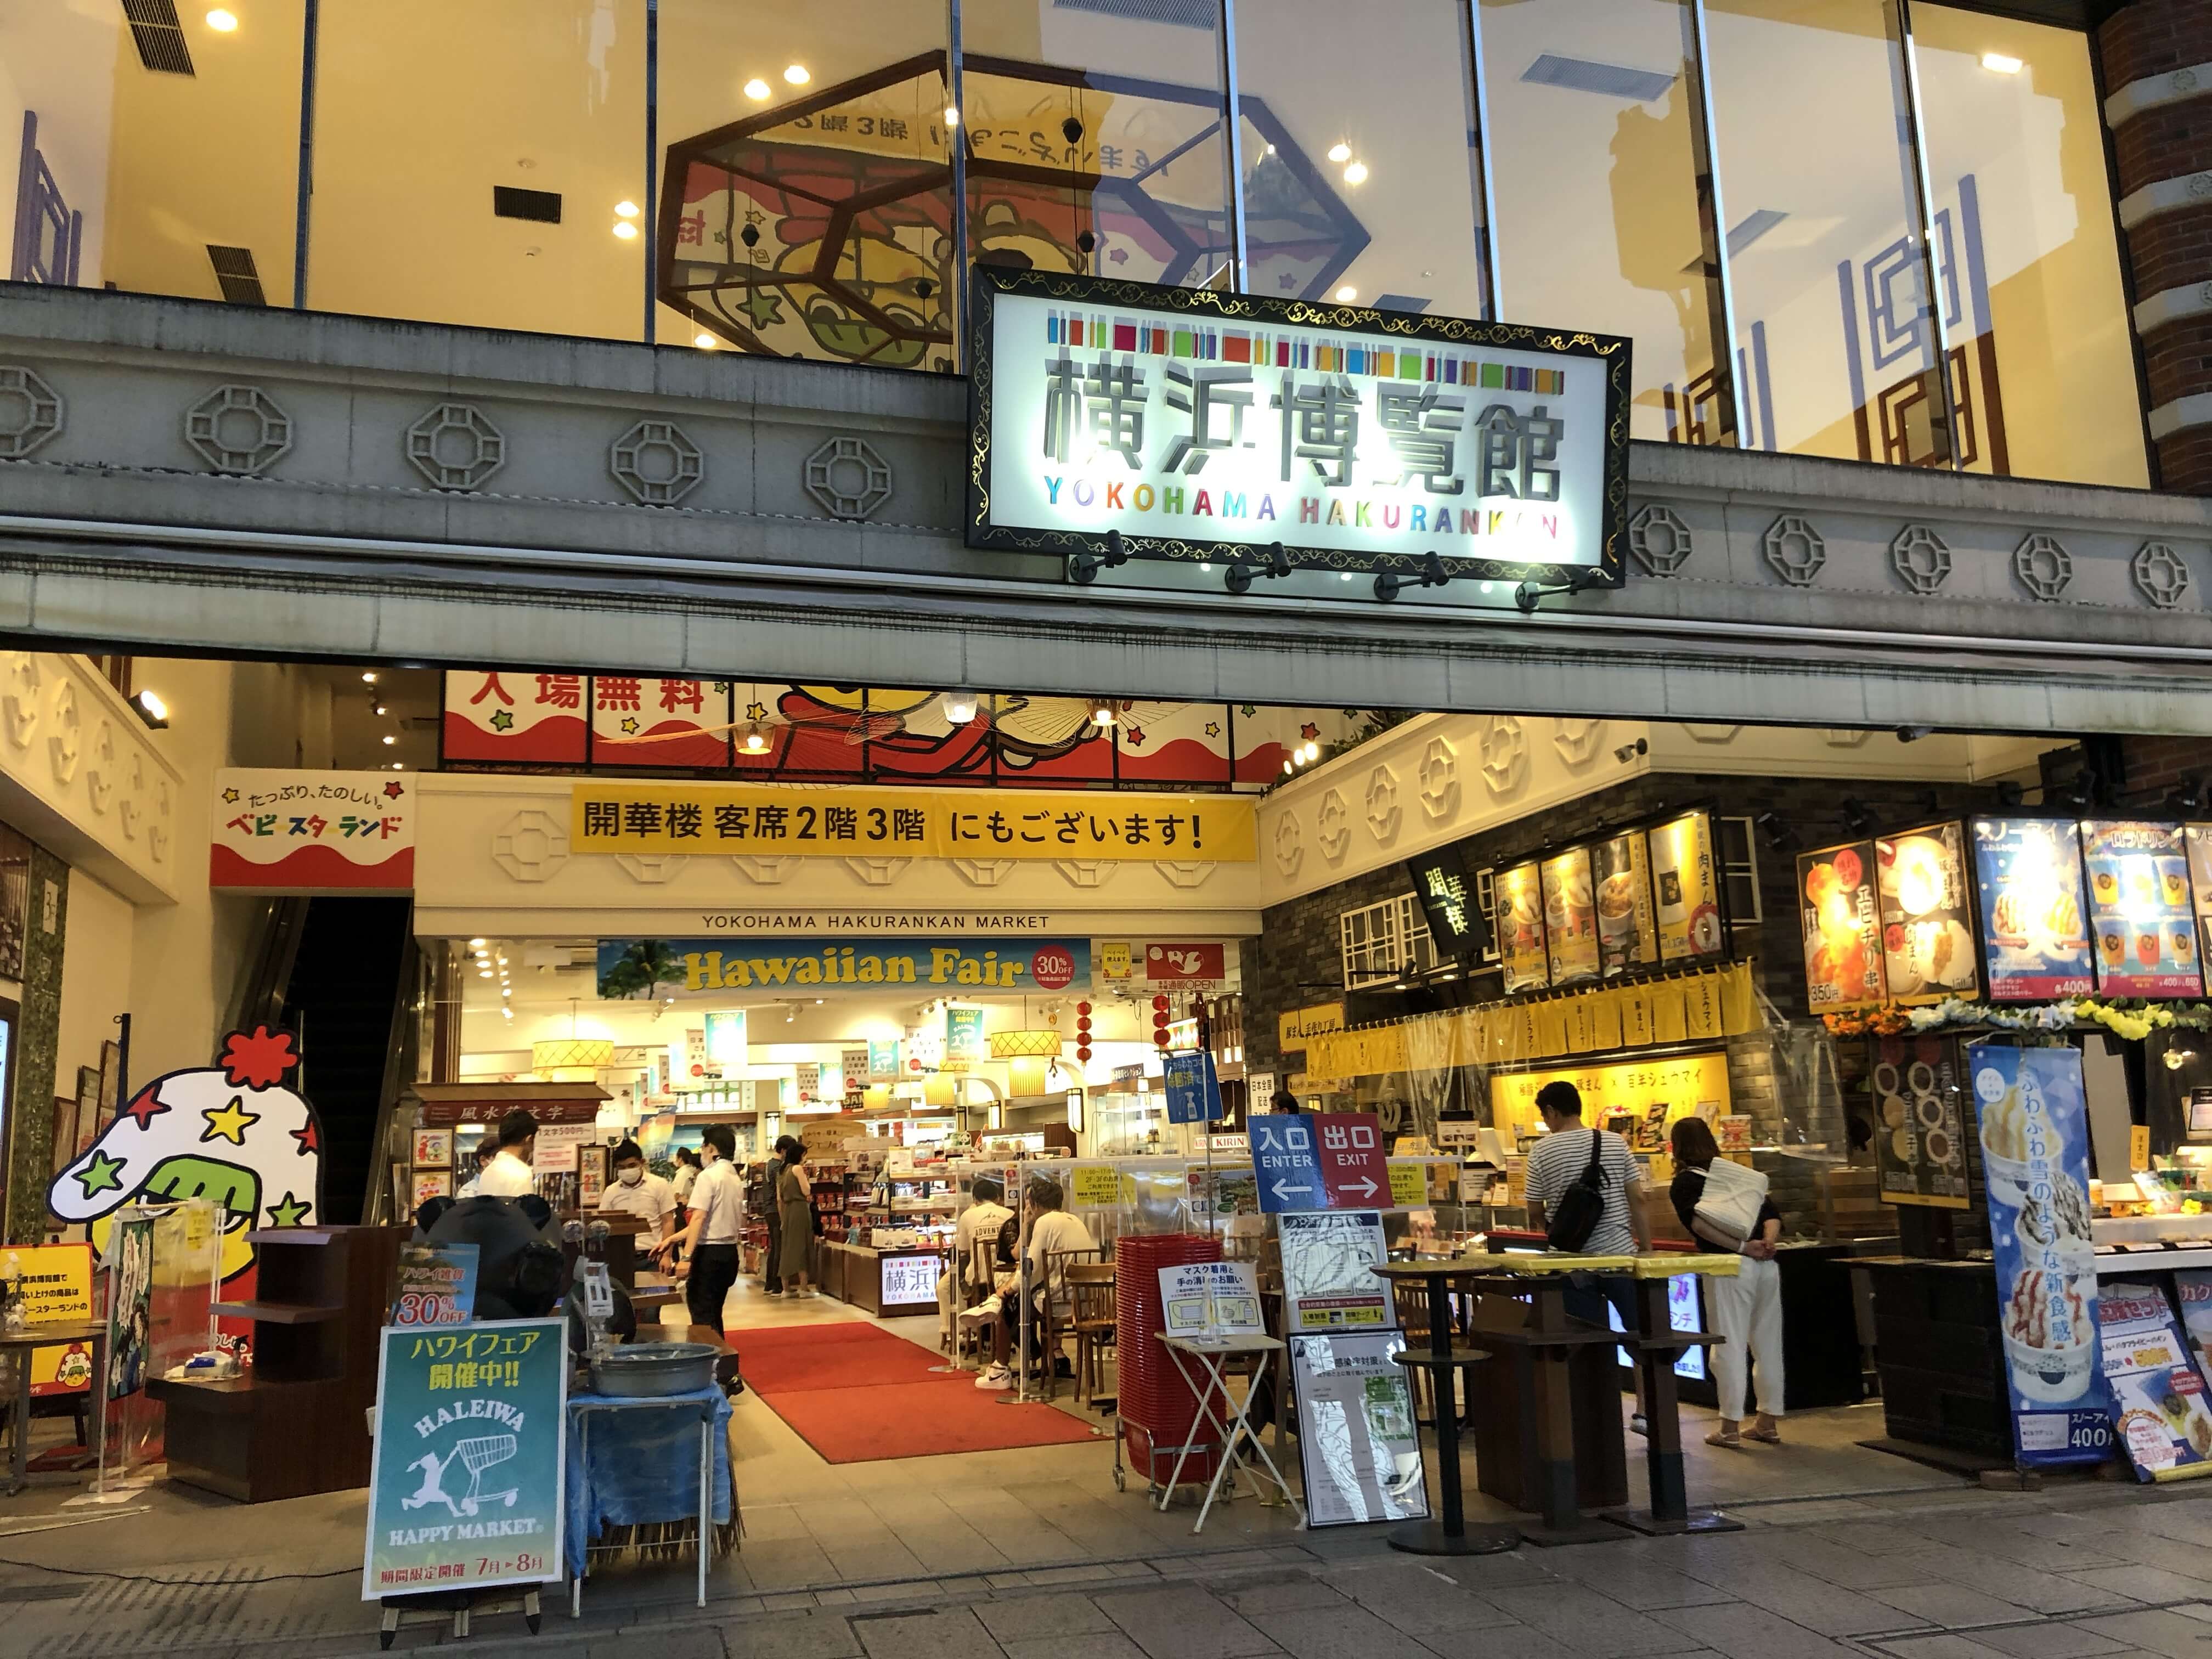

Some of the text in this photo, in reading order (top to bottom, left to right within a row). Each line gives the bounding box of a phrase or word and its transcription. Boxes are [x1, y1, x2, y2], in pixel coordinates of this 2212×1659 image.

[1043, 356, 1565, 503] 横浜博覧館
[1044, 475, 1277, 521] YOKOHAMA
[248, 785, 383, 810] たっぷり、たのしい。
[583, 802, 703, 839] 開華楼
[702, 916, 1049, 929] YOKOHAMA HAKURANKAN MARKET
[684, 947, 1025, 991] Hawaiian Fair
[1037, 956, 1067, 974] 30%
[1216, 1137, 1245, 1147] KIRIN
[1259, 1125, 1375, 1150] 入口 出口
[1262, 1153, 1369, 1168] ENTER EXIT
[2022, 1073, 2072, 1342] ふわふわ雪のような新食感
[975, 1227, 1000, 1236] ADVENT
[398, 1293, 466, 1325] 30% OFF
[411, 1331, 540, 1359] ハワイフェア
[428, 1361, 519, 1390] 開催中!!
[414, 1399, 525, 1437] HALEIWA
[388, 1518, 537, 1546] HAPPY MARKET
[380, 1554, 543, 1584] 期間限定開催 7月 8月
